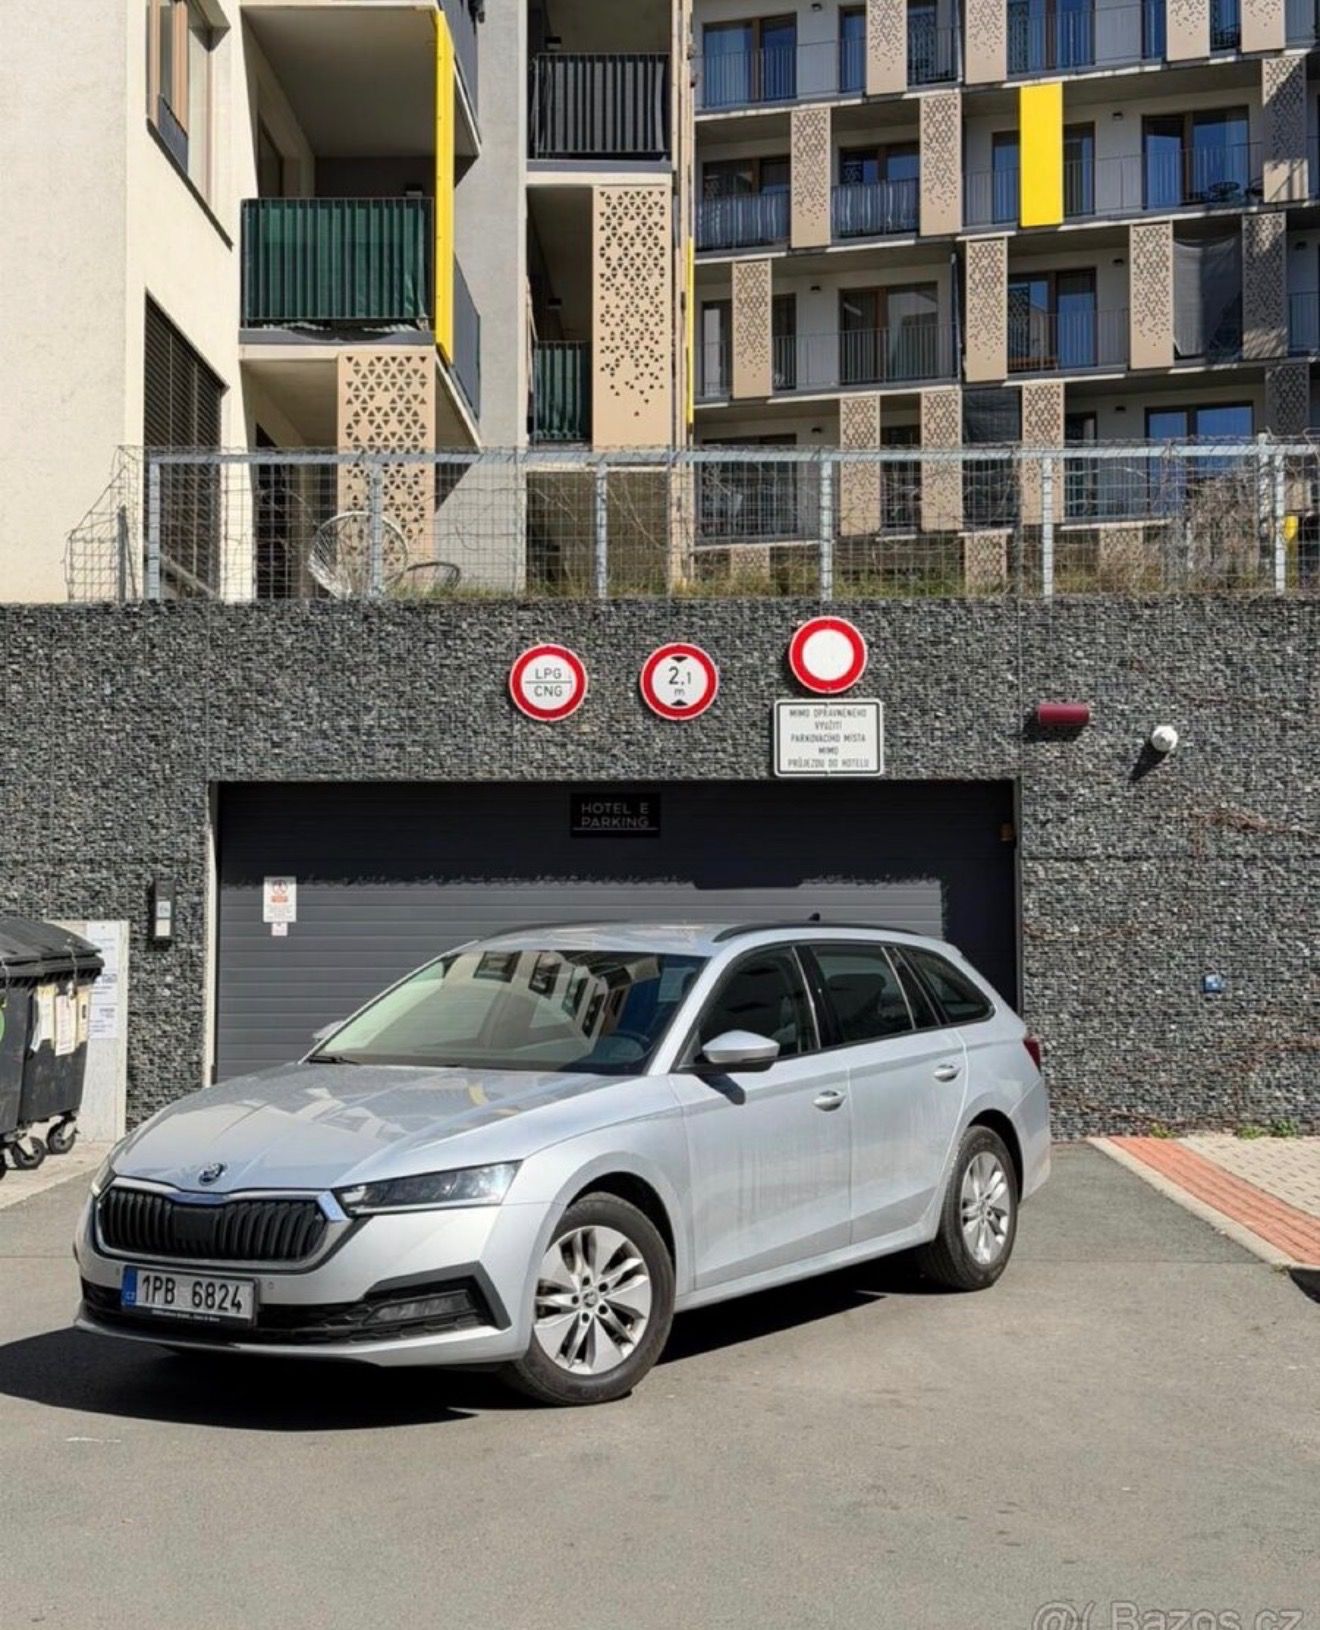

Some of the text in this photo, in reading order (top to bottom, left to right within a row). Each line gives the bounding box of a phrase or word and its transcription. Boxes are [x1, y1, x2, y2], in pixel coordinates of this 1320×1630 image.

[535, 667, 562, 680] LPG
[534, 685, 563, 698] CNG
[674, 688, 686, 697] m
[789, 709, 811, 718] MIMO
[818, 746, 839, 756] MIMO
[828, 758, 839, 768] DO
[842, 758, 870, 768] HOTELU
[581, 802, 650, 815] HOTEL E
[581, 816, 650, 828] PARKING
[141, 1274, 243, 1313] 1PB 6824
